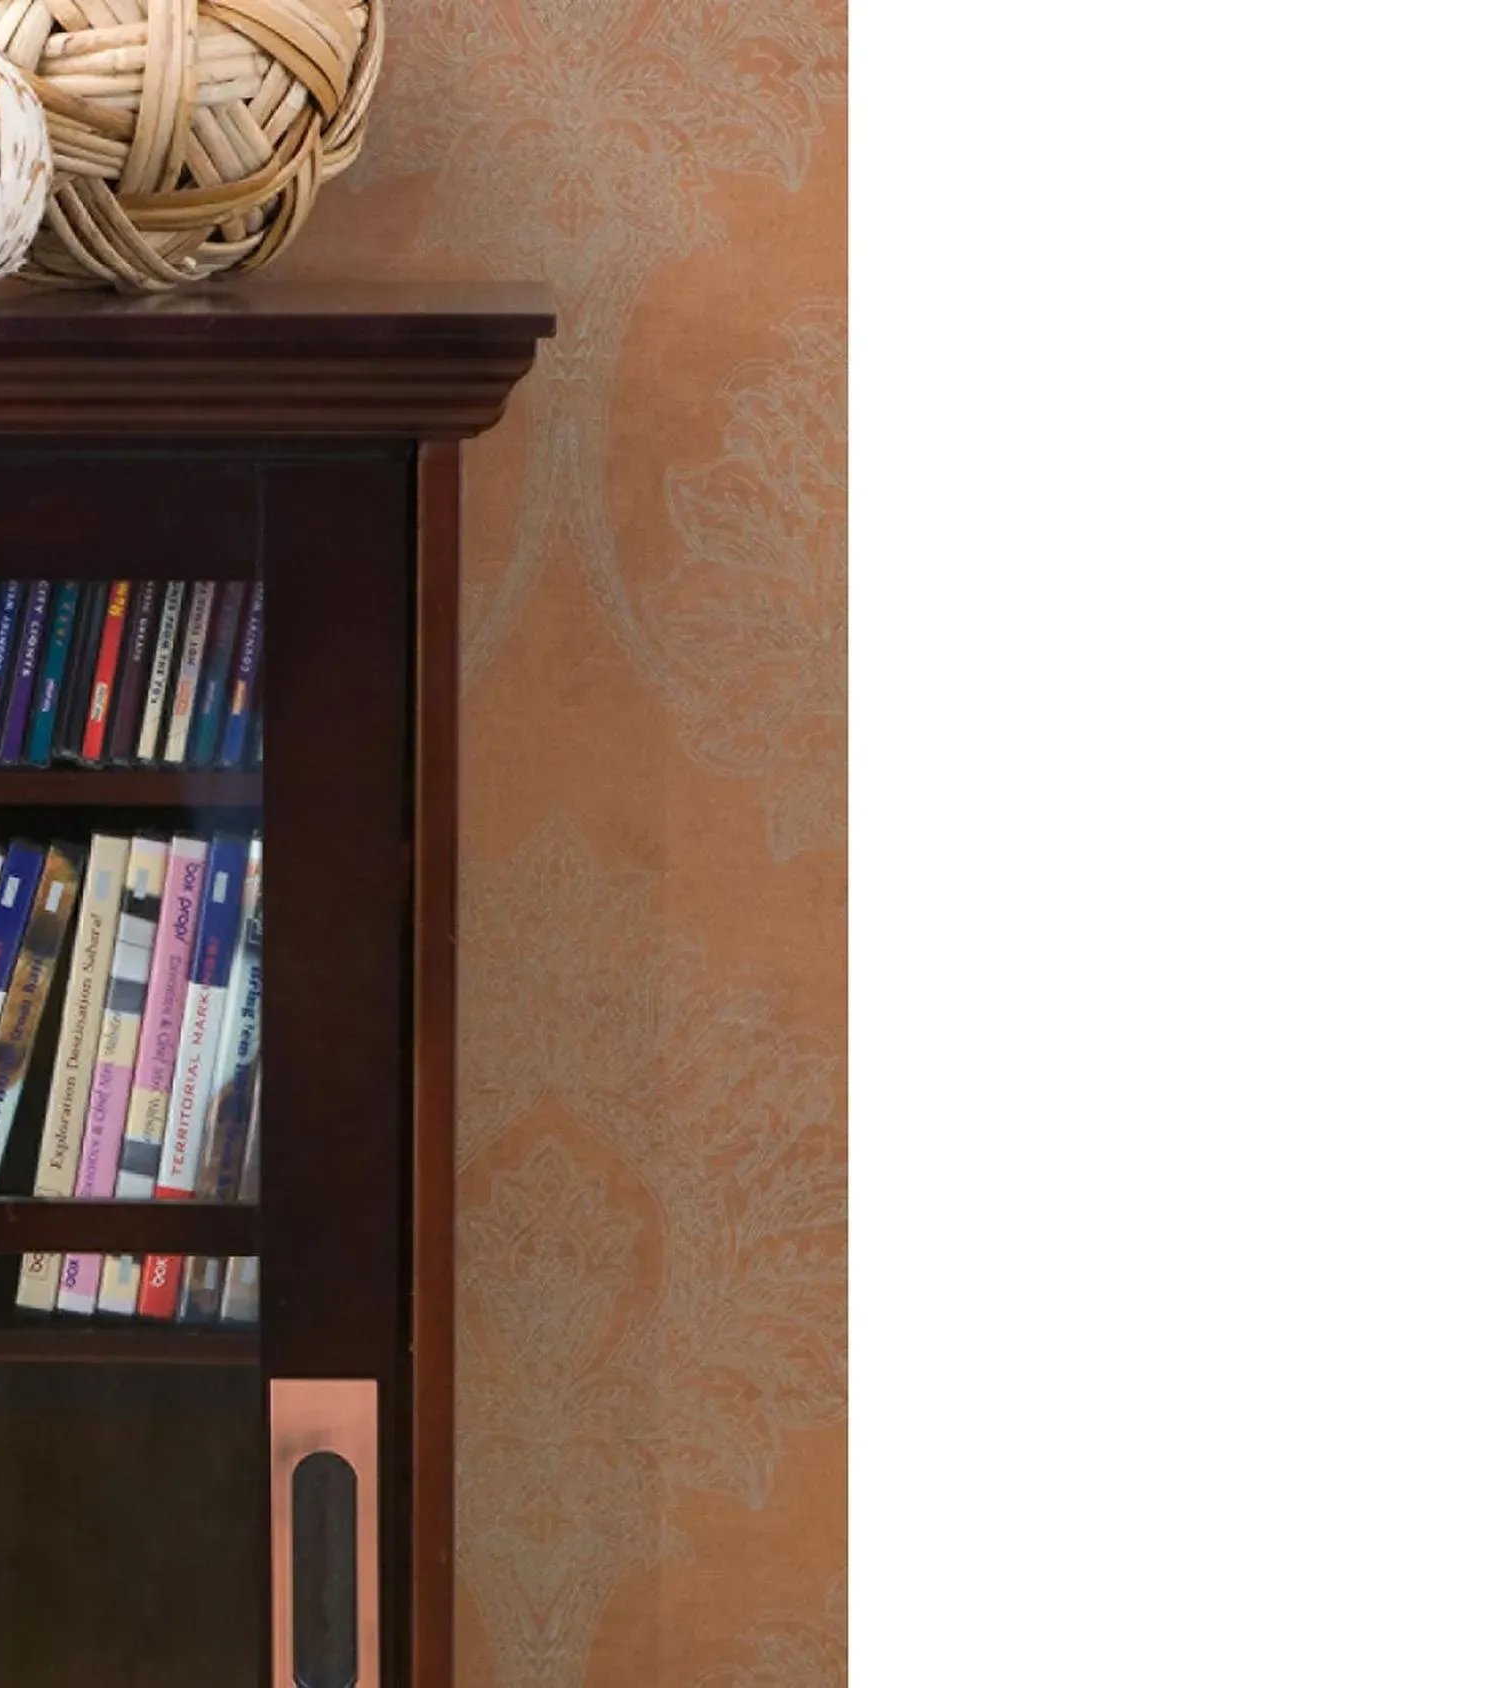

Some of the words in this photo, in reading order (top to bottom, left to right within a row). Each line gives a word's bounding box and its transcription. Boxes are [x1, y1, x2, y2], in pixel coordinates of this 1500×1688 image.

[33, 580, 51, 614] CITY
[21, 619, 42, 678] LIGHTS
[161, 615, 178, 650] FROM
[156, 654, 169, 678] THE
[183, 862, 201, 893] box
[49, 1075, 81, 1172] Exploration
[65, 976, 97, 1073] Destination
[82, 913, 104, 974] Sahara!
[170, 1054, 202, 1177] TERRITORIAL
[65, 1258, 81, 1290] box
[150, 1256, 169, 1288] box
